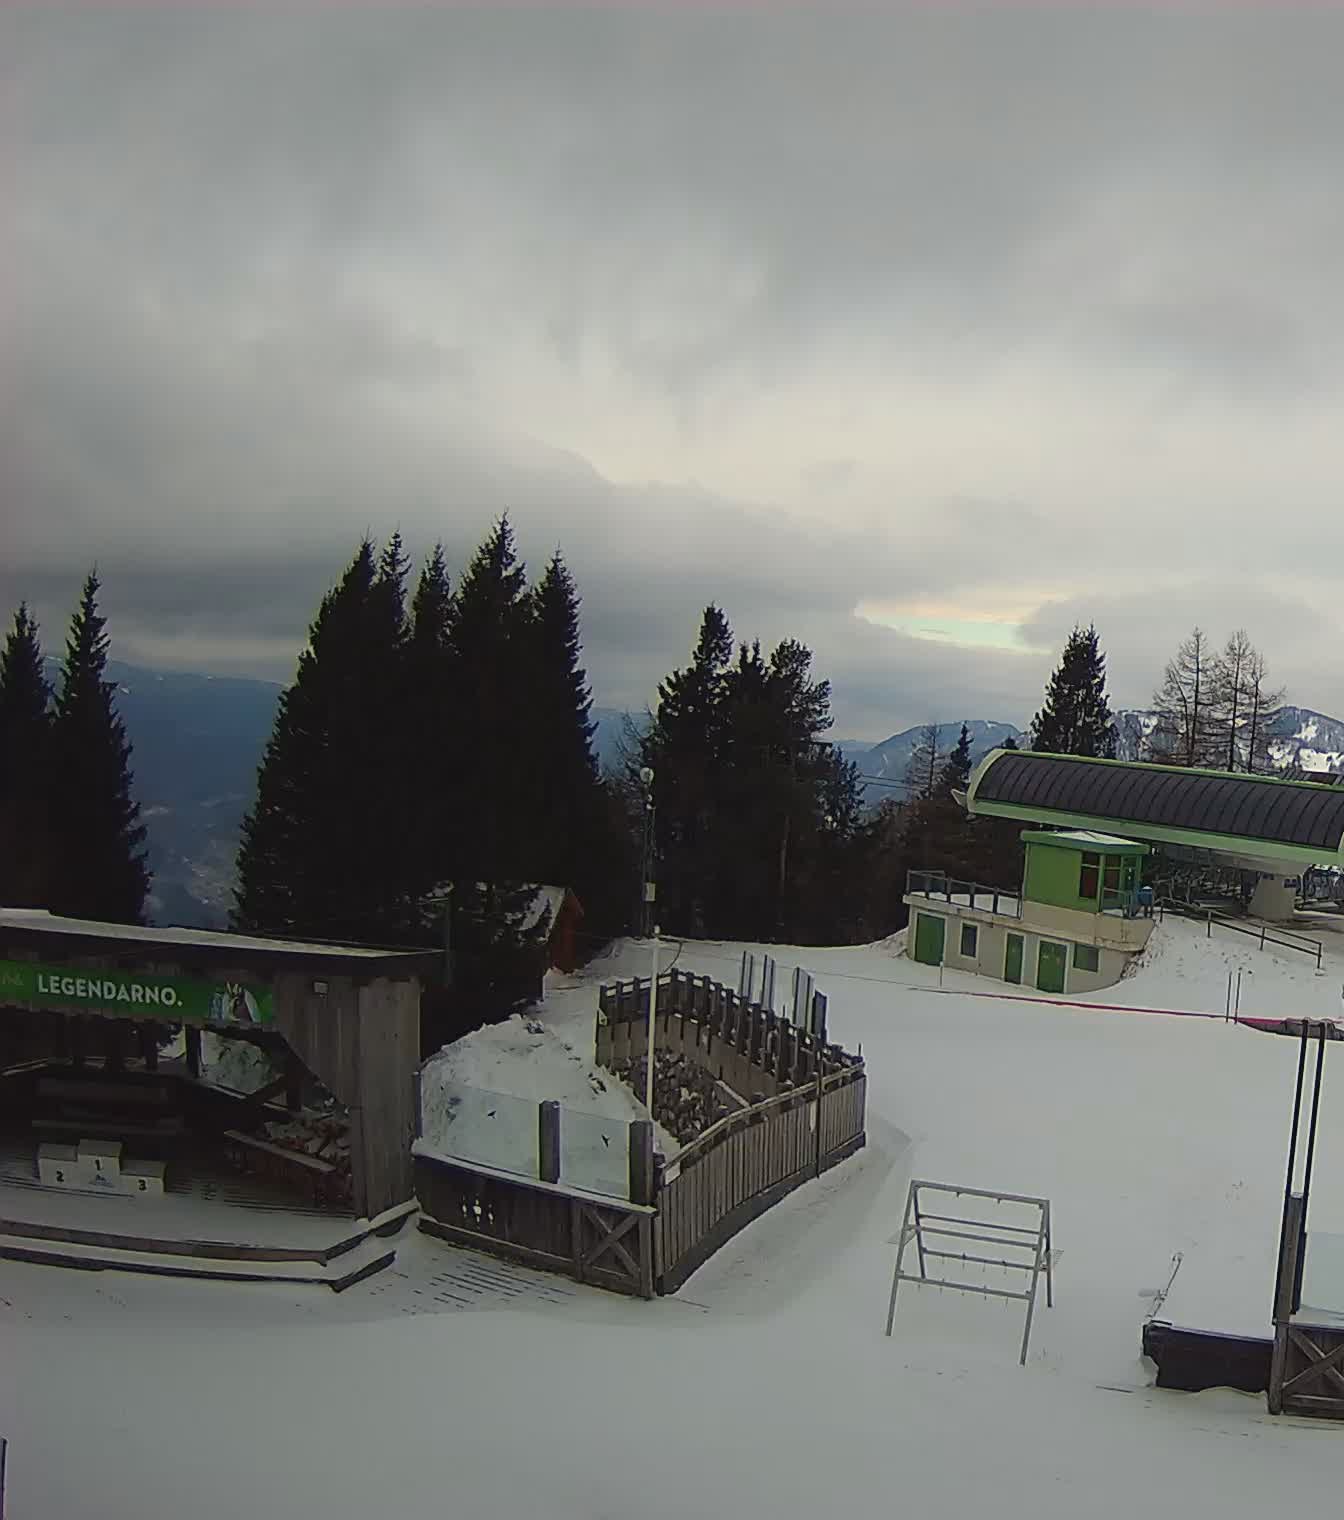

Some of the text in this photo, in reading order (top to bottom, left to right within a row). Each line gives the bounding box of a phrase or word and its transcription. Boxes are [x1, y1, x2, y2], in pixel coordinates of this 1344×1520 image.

[38, 975, 183, 1006] LEGENDARNO.
[56, 1171, 64, 1182] 2
[138, 1179, 147, 1191] 3
